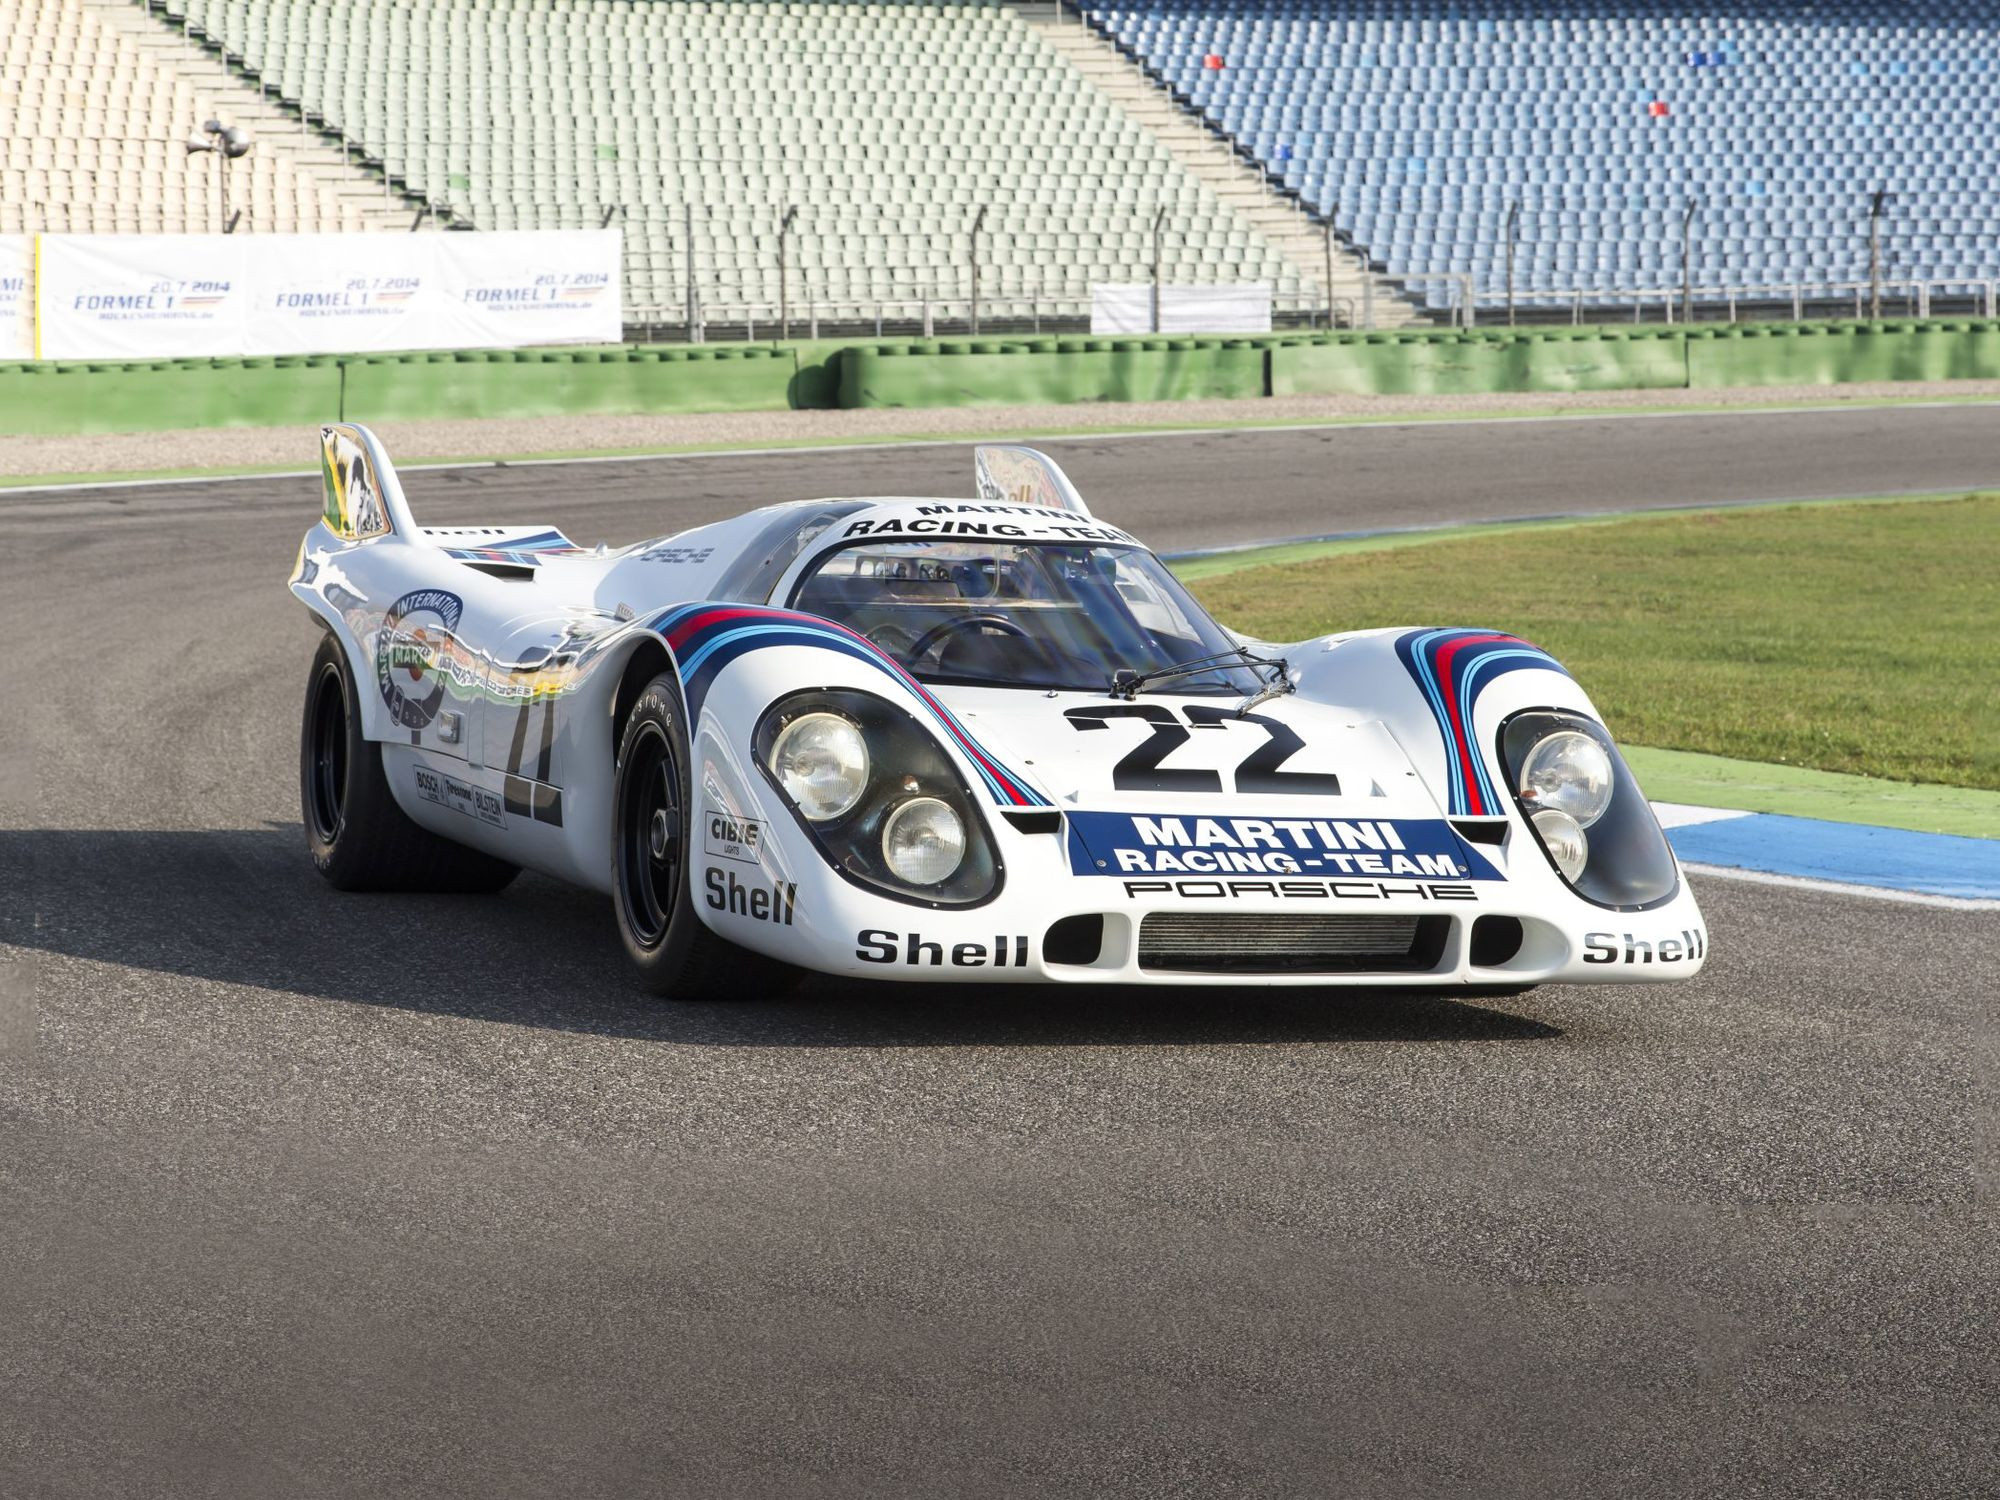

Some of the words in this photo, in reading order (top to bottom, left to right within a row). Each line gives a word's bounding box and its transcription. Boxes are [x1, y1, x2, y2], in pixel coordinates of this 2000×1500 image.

[345, 276, 421, 291] 20.7.2014
[536, 272, 610, 286] 20.7.2014
[73, 295, 155, 311] FORMEL
[165, 295, 174, 310] 1
[275, 293, 350, 308] FORMEL
[361, 292, 369, 306] 1
[463, 287, 540, 304] FORMEL
[549, 287, 557, 301] 1
[915, 505, 1090, 524] MARTINI
[1063, 704, 1343, 797] 22
[416, 771, 440, 796] BOSCH
[1130, 816, 1406, 851] MARTINI
[705, 866, 798, 926] Shell
[1123, 881, 1479, 901] PORSCHE
[855, 929, 1029, 967] Shell
[1583, 928, 1703, 964] Shell
